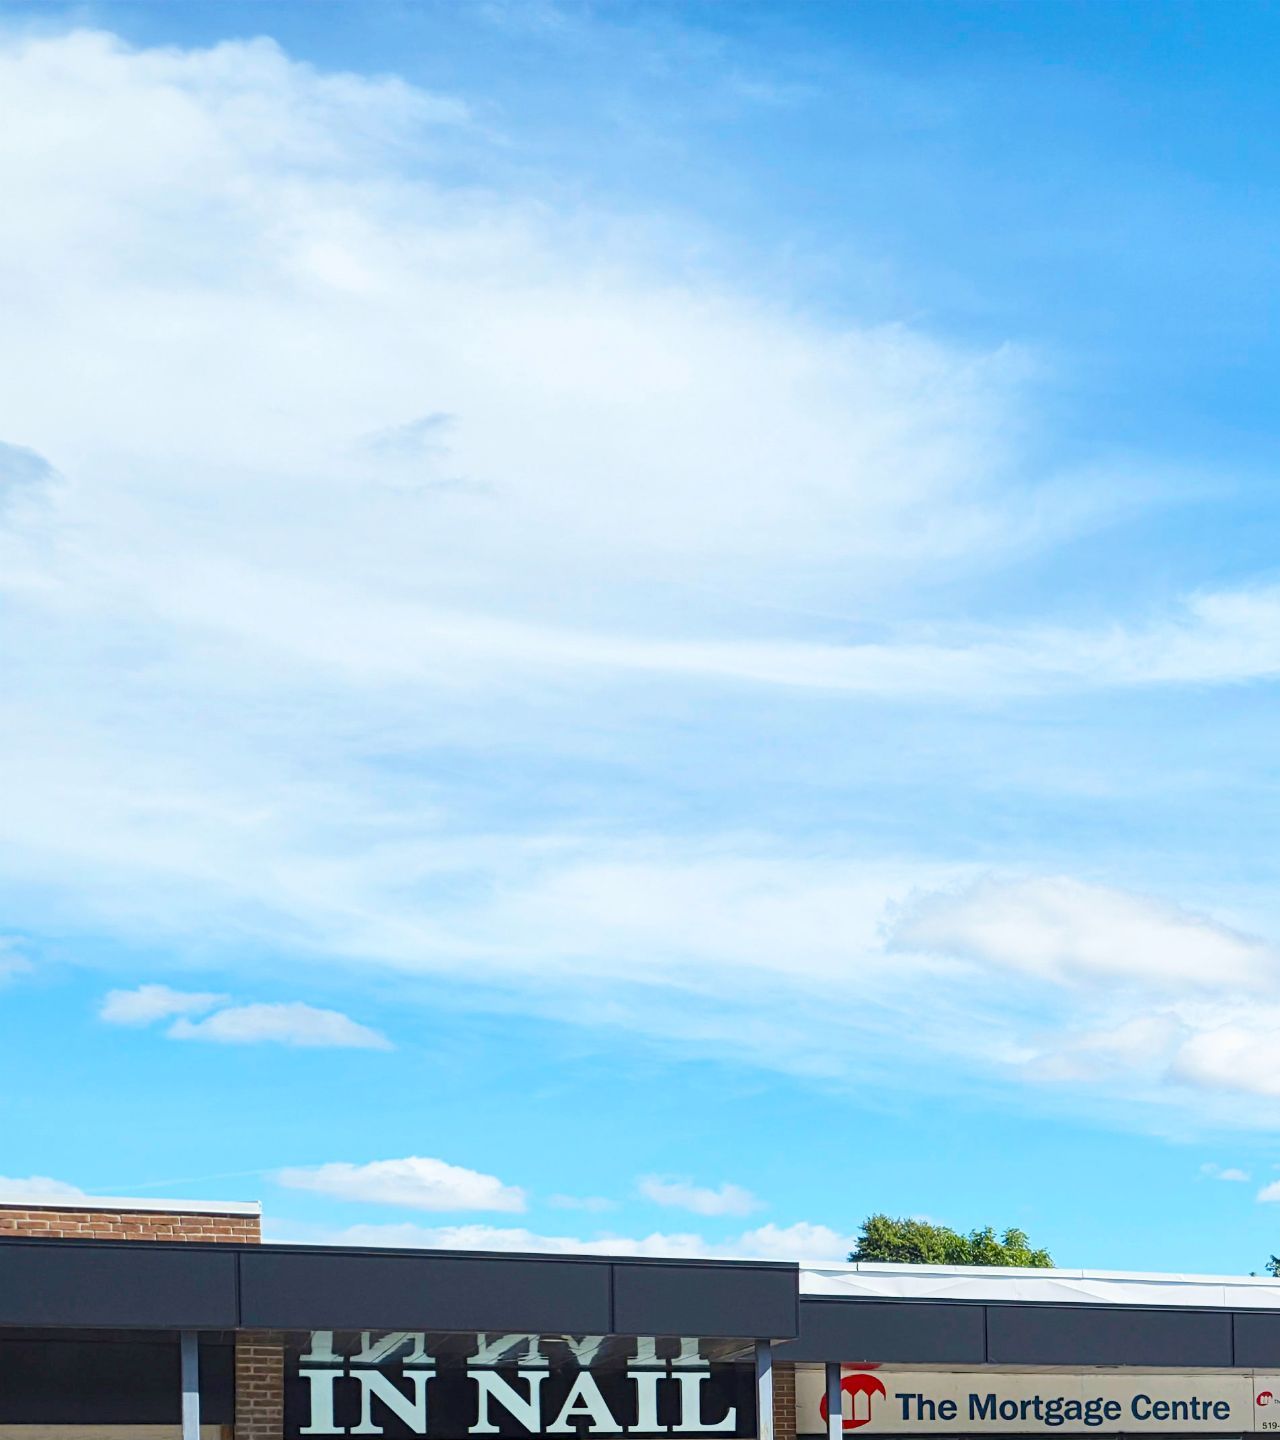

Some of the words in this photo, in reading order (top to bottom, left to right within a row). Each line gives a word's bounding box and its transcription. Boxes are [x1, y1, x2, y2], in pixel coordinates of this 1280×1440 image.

[299, 1370, 436, 1434] IN
[467, 1370, 736, 1433] NAIL
[895, 1393, 957, 1421] The
[969, 1393, 1122, 1426] Mortgage
[1126, 1393, 1231, 1421] Centre
